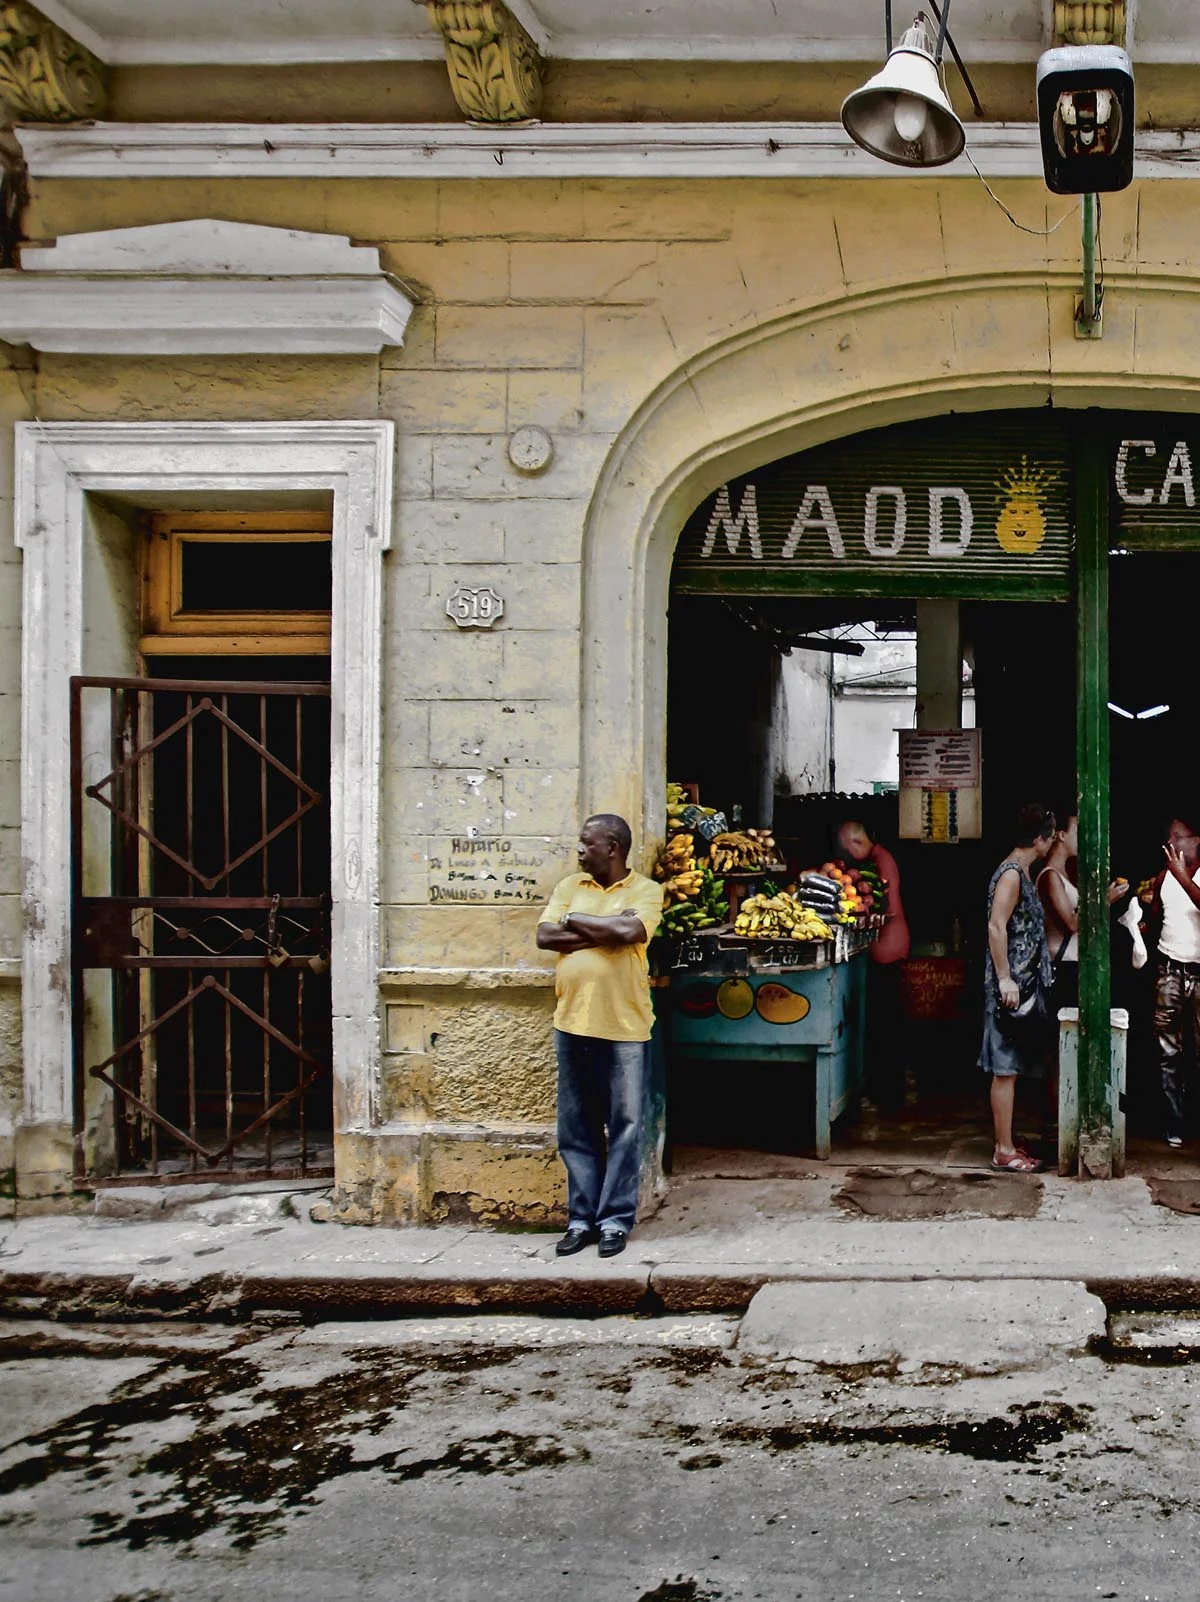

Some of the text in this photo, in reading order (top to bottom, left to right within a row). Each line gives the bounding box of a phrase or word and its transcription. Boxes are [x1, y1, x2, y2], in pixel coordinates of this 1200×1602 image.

[700, 484, 974, 558] MAOD
[458, 595, 491, 618] 519
[451, 838, 512, 854] Horario
